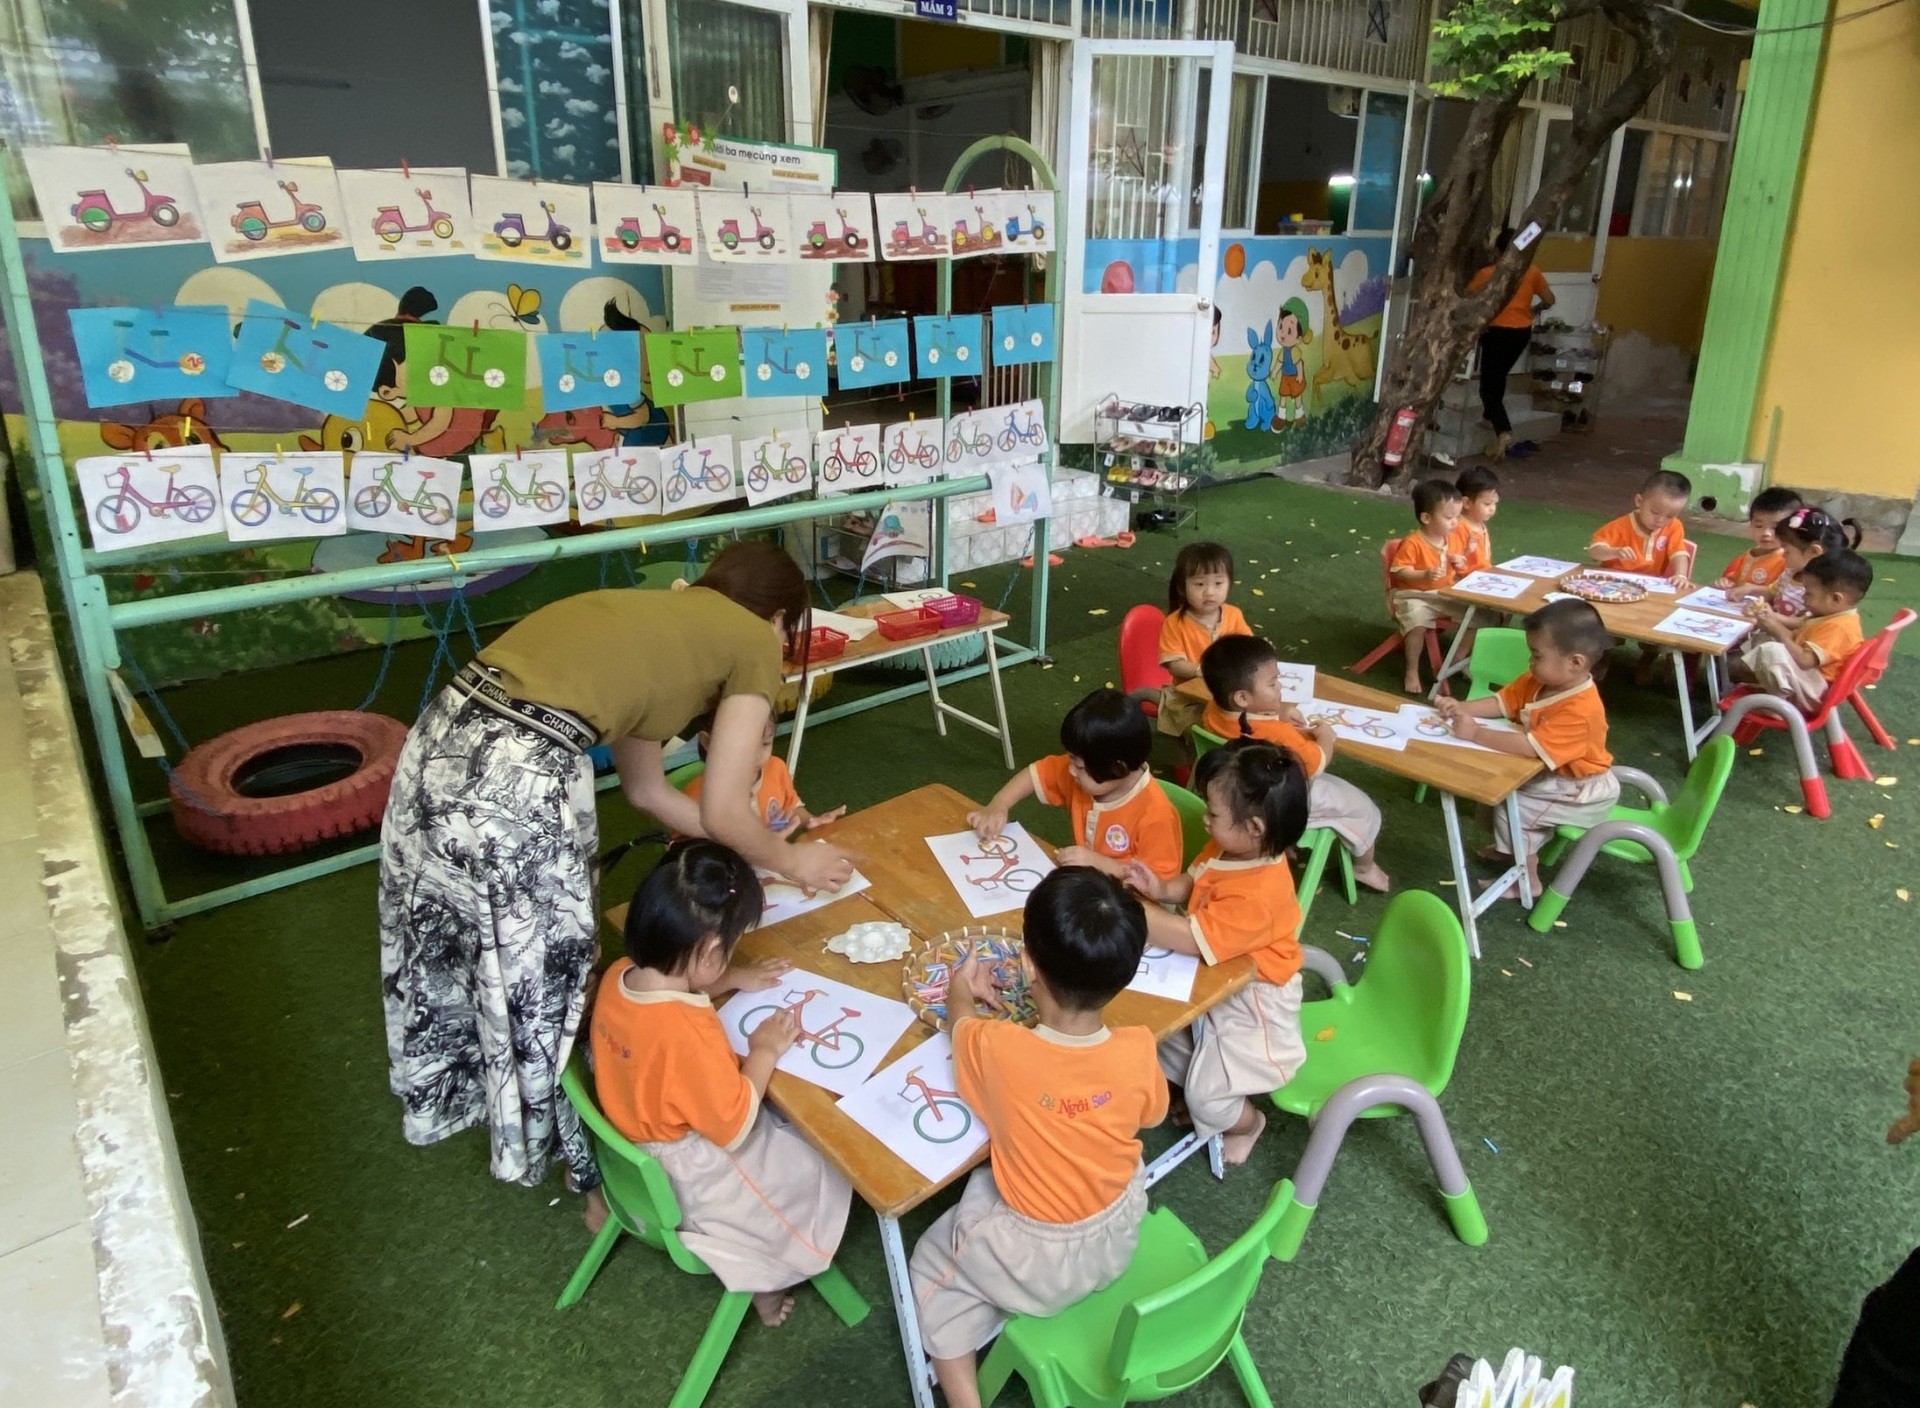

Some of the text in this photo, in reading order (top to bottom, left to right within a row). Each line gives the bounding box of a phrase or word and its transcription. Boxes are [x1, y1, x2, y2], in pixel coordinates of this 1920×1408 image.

[946, 4, 953, 16] 2
[724, 144, 737, 155] ba
[779, 155, 801, 165] xem
[481, 682, 512, 707] CHANEL
[1057, 1098, 1090, 1119] Ngôi
